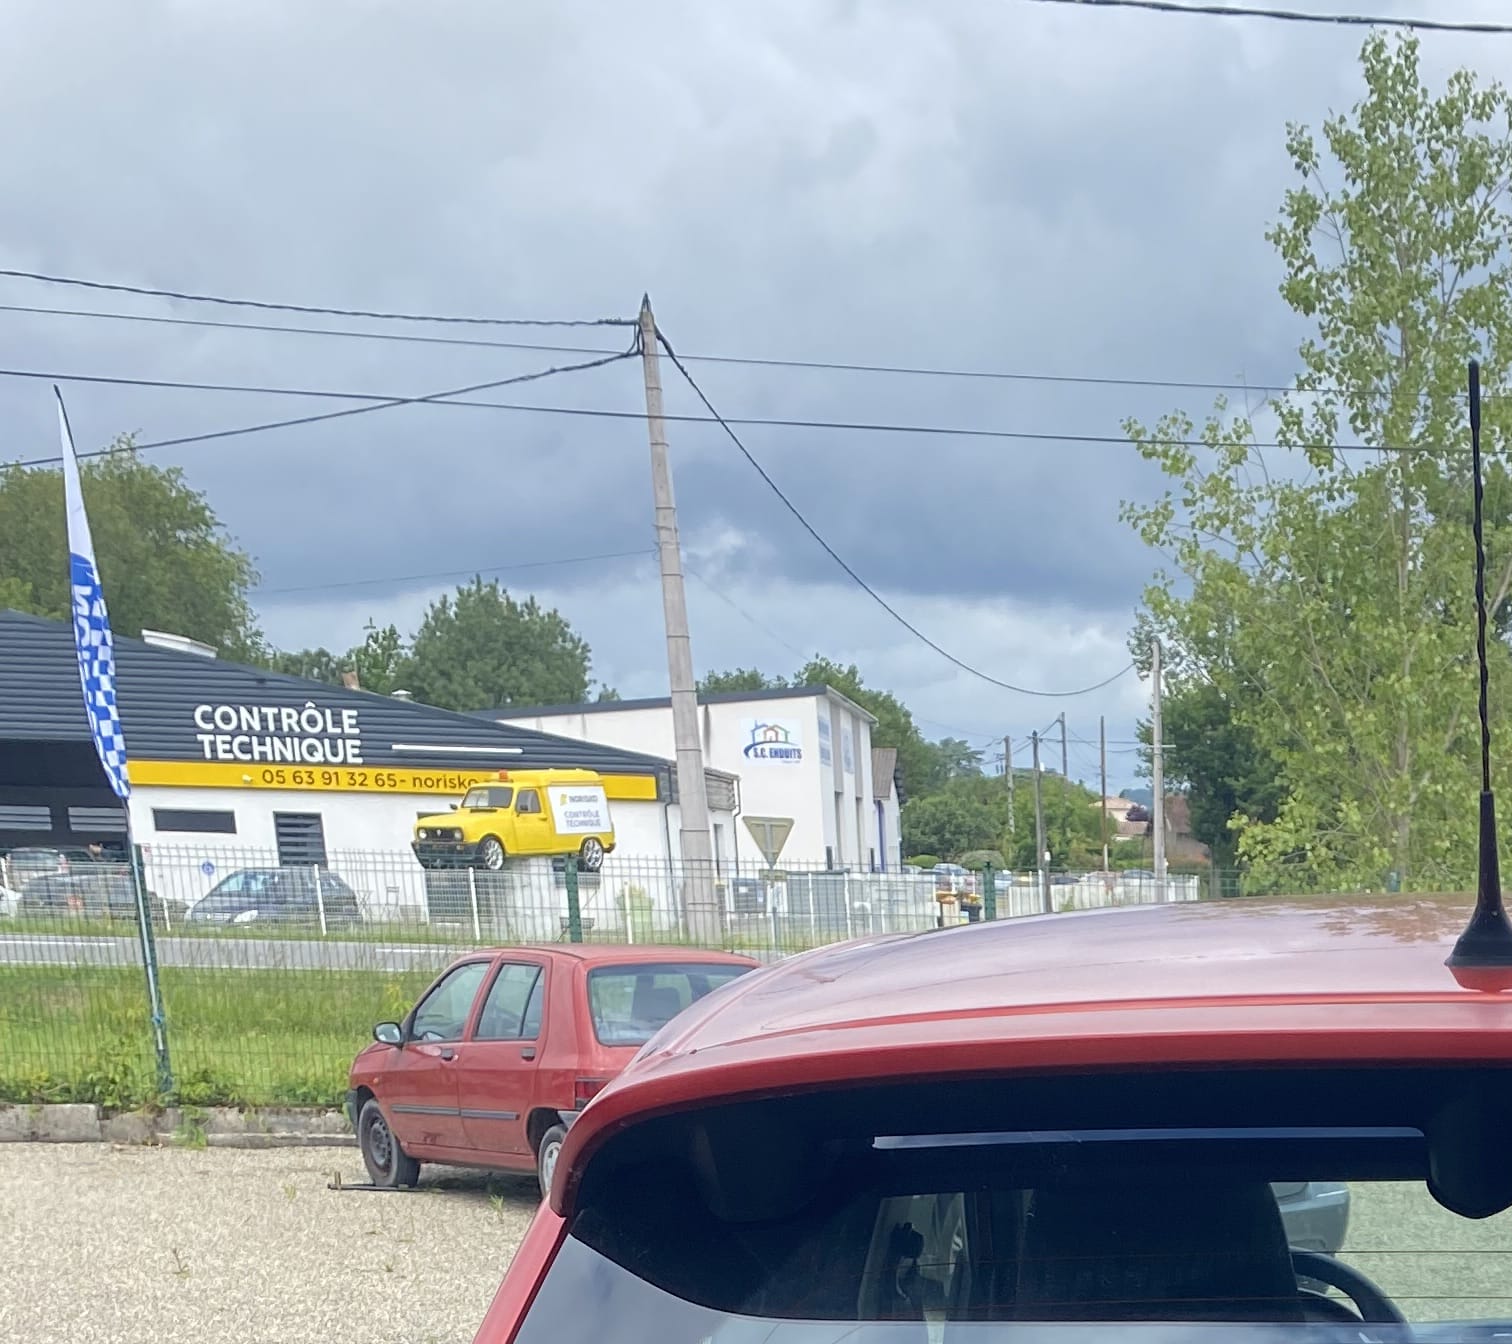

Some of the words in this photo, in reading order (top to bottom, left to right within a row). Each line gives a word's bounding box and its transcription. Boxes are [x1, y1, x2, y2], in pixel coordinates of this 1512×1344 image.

[194, 701, 360, 734] CONTRÔLE
[196, 734, 363, 764] TECHNIQUE
[262, 769, 286, 784] 05
[292, 770, 315, 785] 63
[321, 771, 340, 786] 91
[347, 772, 368, 787] 32
